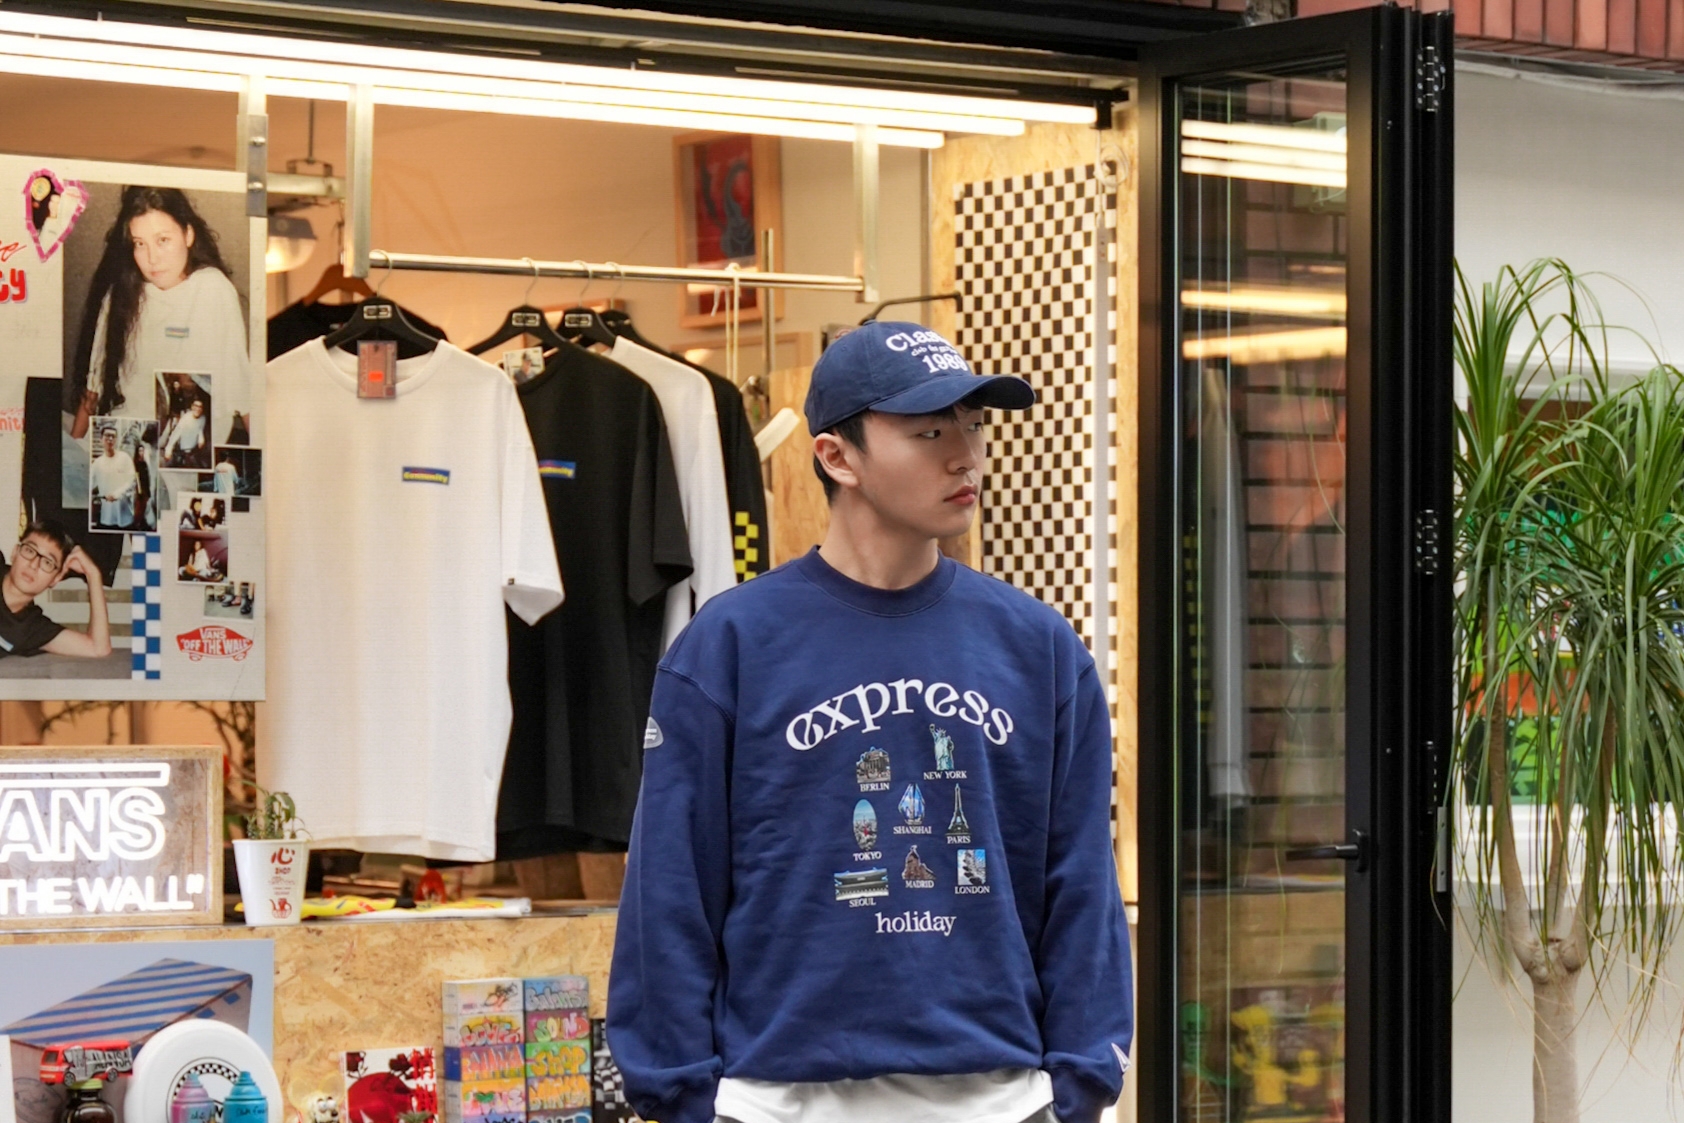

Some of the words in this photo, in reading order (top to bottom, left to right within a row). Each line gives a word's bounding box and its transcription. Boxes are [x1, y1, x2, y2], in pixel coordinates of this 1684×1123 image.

[922, 353, 968, 373] 1989
[199, 628, 226, 639] VANS
[203, 639, 222, 655] THE
[786, 678, 1014, 751] express
[923, 772, 943, 780] NEW
[945, 771, 968, 779] YORK
[860, 782, 890, 792] BERLIN
[0, 763, 170, 863] ANS
[893, 826, 932, 834] SHANGHAI
[947, 835, 971, 844] PARIS
[853, 852, 882, 862] TOKYO
[905, 880, 934, 888] MADRID
[955, 886, 990, 894] LONDON
[849, 898, 876, 907] SEOUL
[875, 910, 957, 936] holiday
